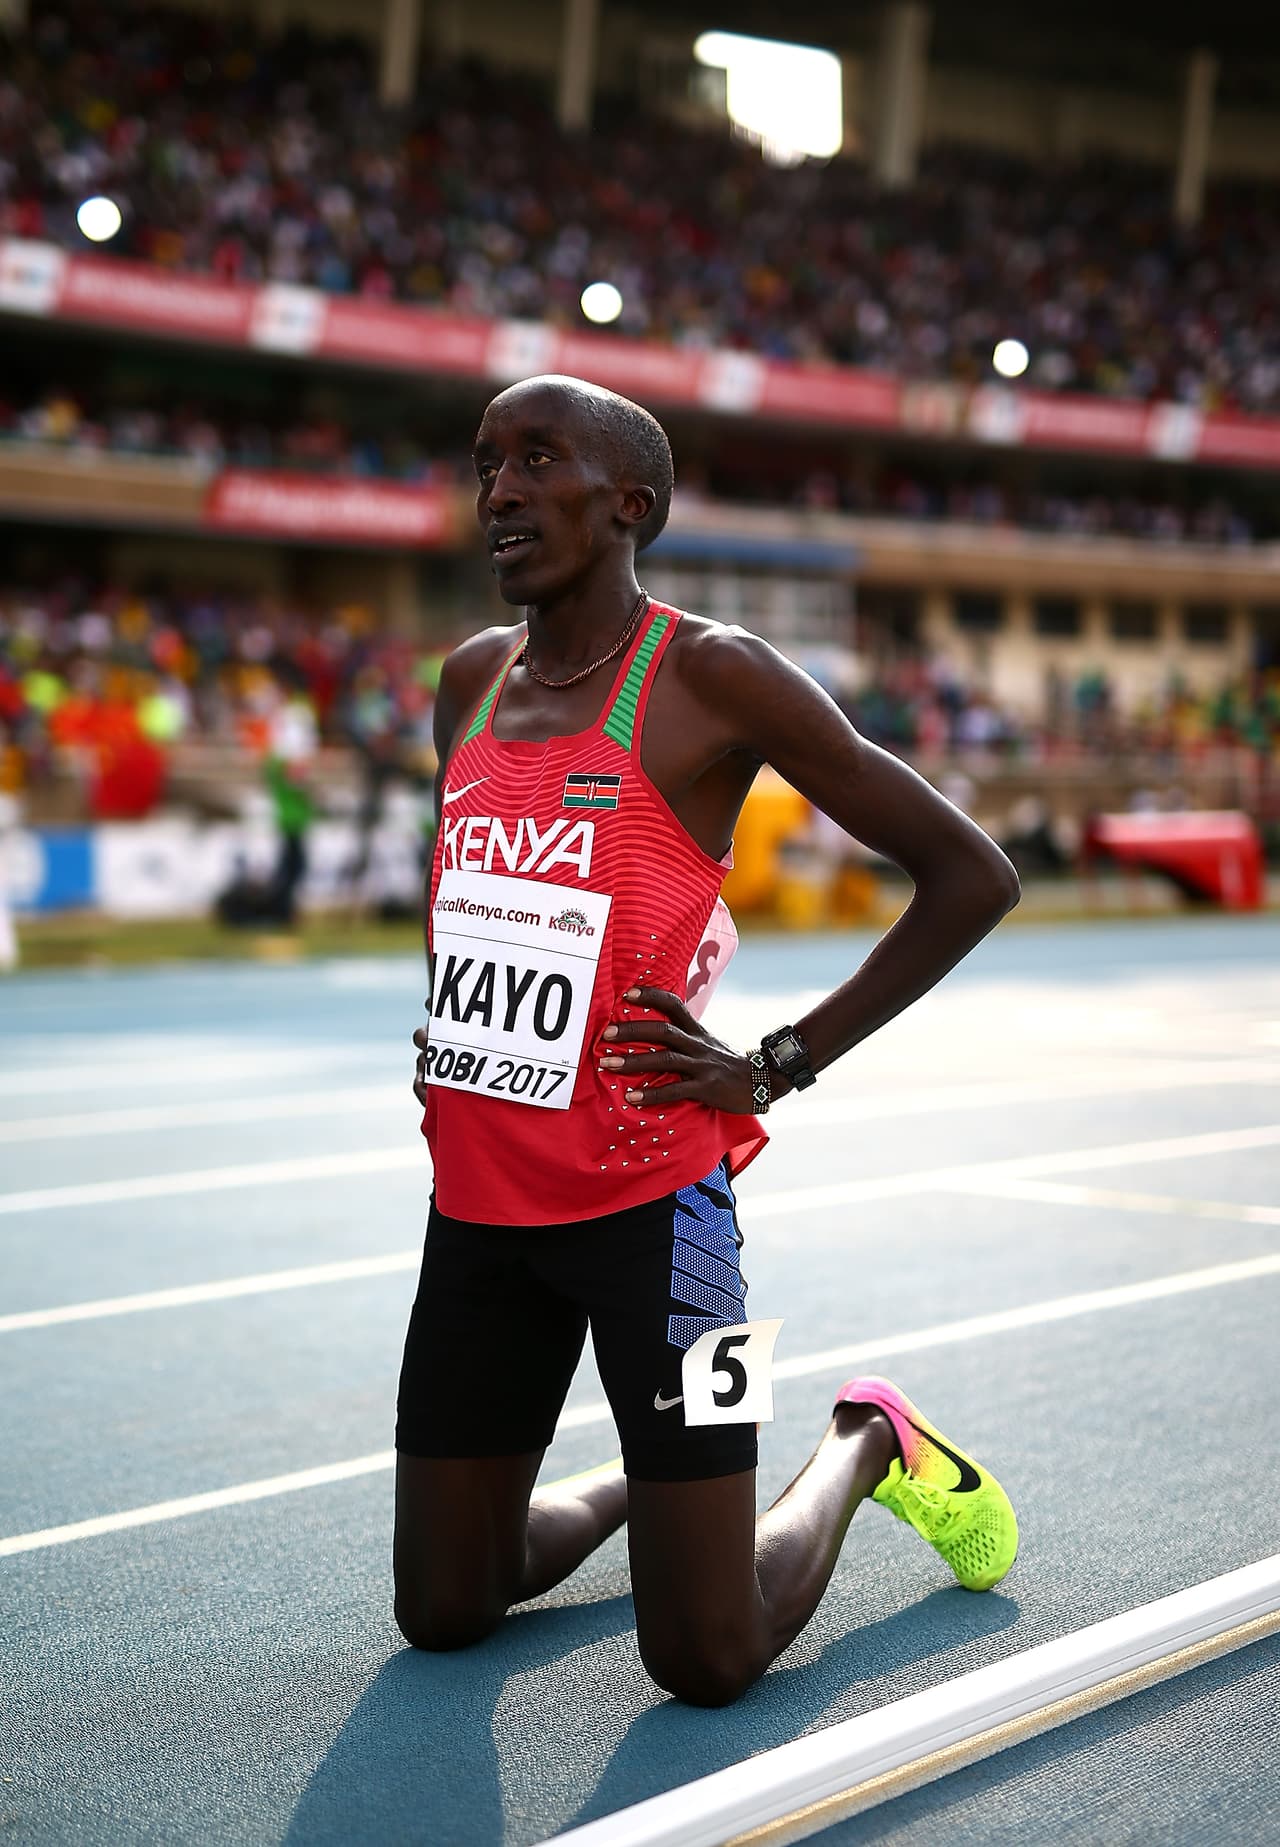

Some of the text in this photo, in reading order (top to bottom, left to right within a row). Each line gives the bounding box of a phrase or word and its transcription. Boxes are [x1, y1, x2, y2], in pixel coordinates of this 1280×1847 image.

[442, 816, 595, 878] KENYA
[548, 915, 595, 937] Kenya
[430, 953, 573, 1041] KAYO
[487, 1060, 568, 1099] 2017
[711, 1334, 751, 1408] 5
